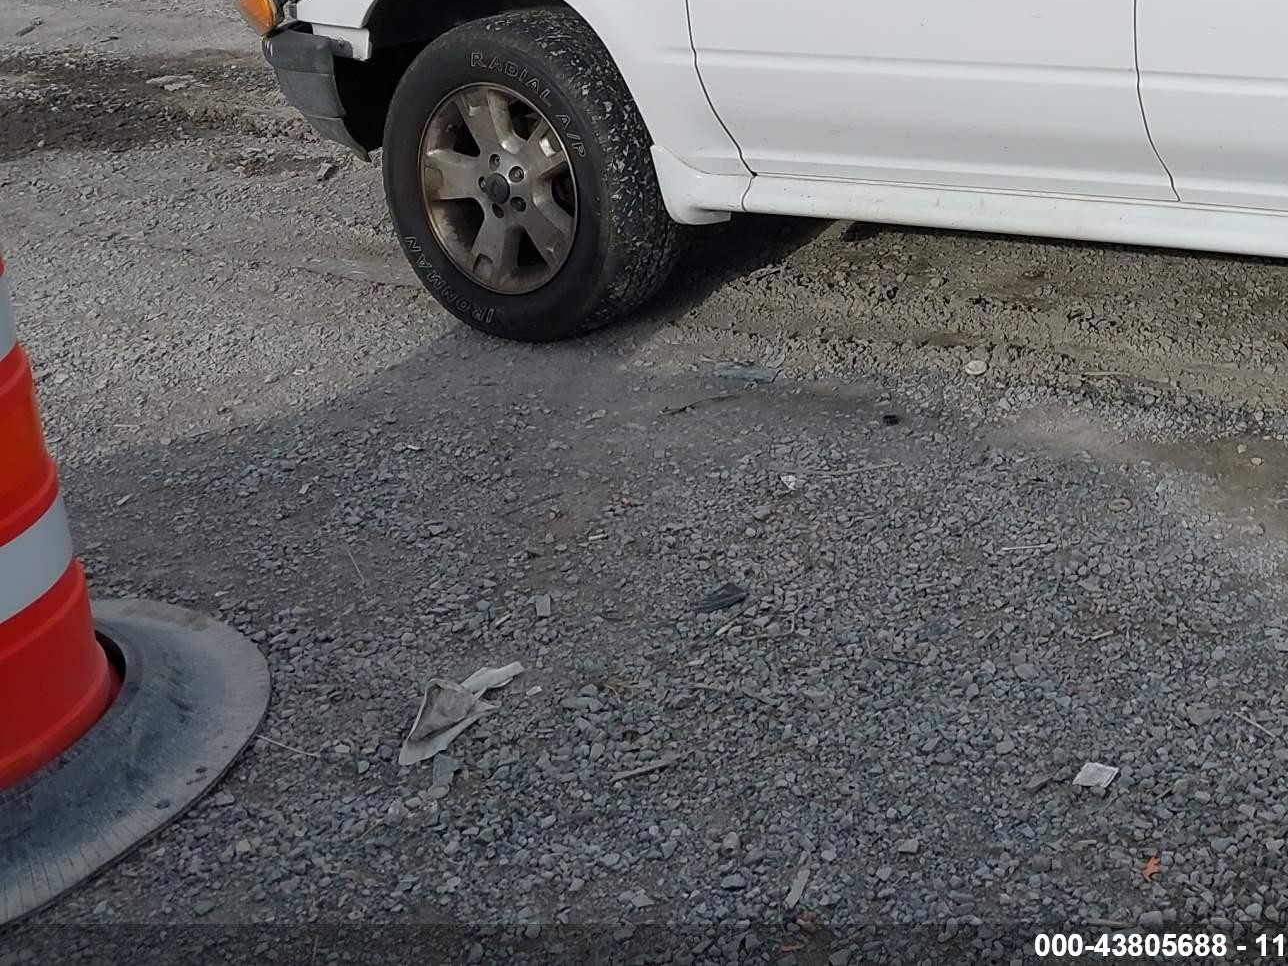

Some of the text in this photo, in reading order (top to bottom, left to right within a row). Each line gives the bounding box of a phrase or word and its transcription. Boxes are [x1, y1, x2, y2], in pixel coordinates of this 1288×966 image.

[470, 51, 586, 159] RADIAL A/P
[404, 236, 495, 323] IRONMAN
